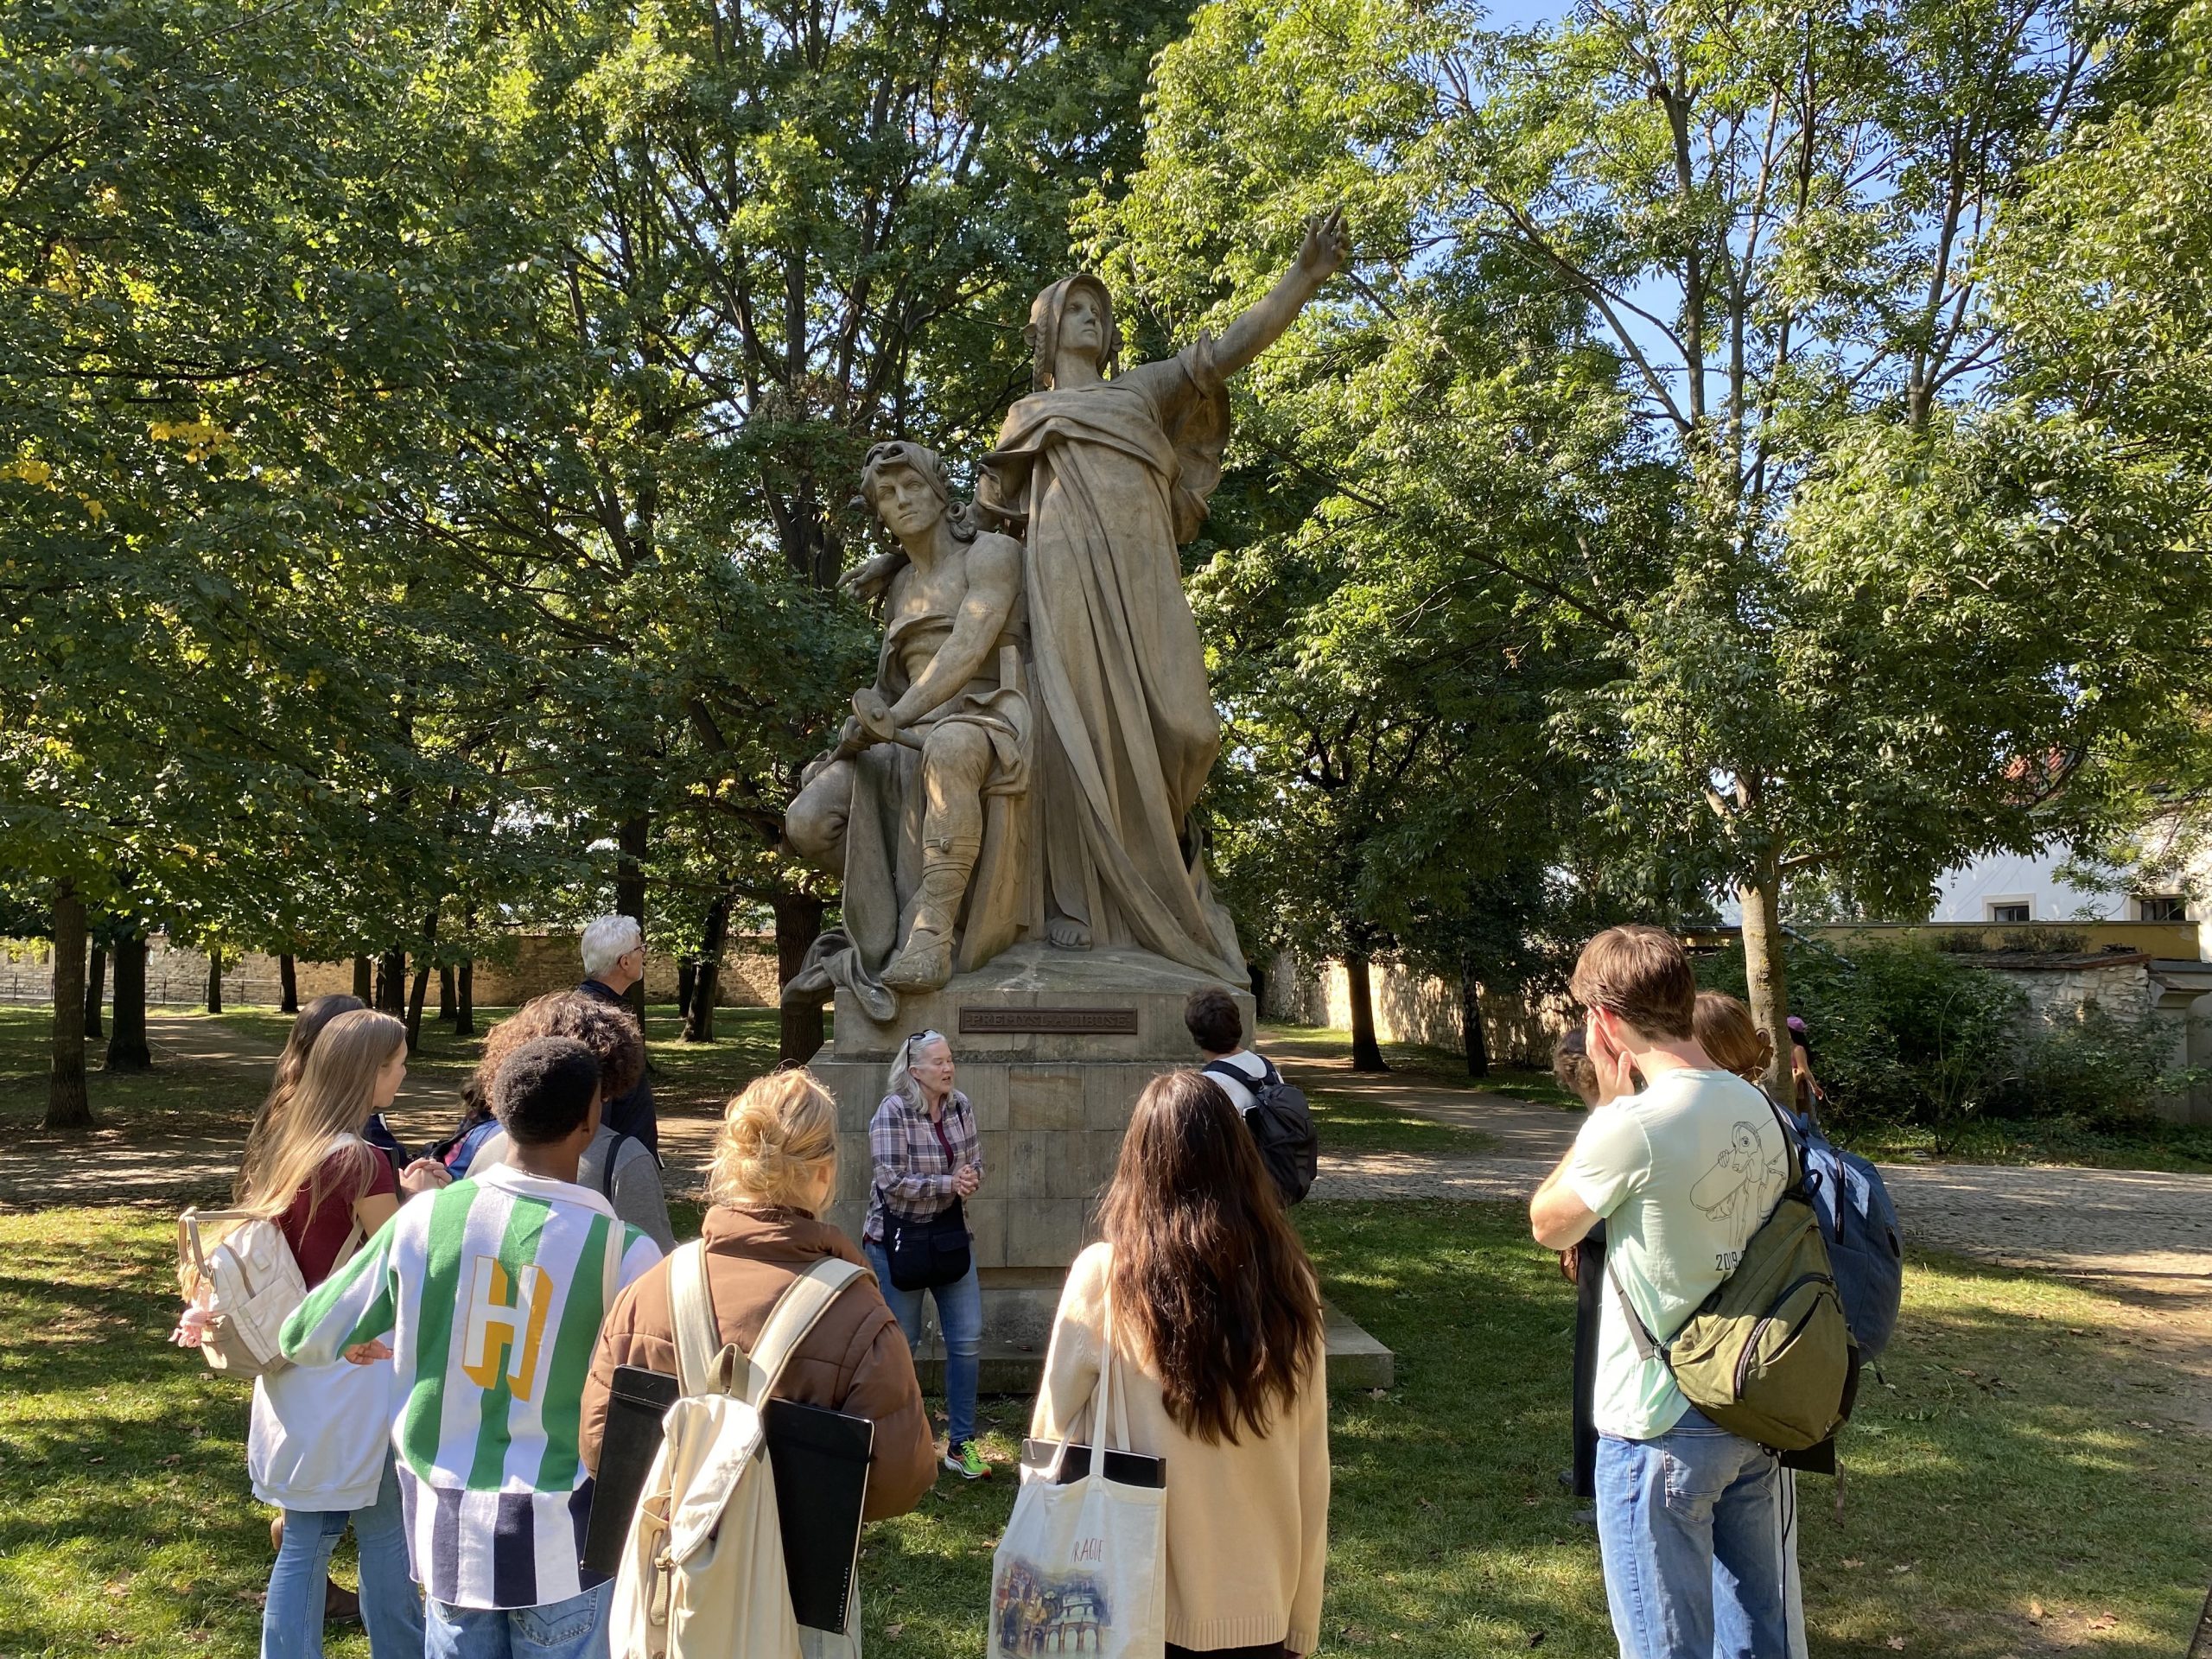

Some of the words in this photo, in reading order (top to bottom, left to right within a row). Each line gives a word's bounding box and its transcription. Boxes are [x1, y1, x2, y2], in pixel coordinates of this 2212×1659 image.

[1055, 1014, 1064, 1026] A
[1070, 1013, 1127, 1027] LIBUŠE
[461, 1255, 554, 1402] H
